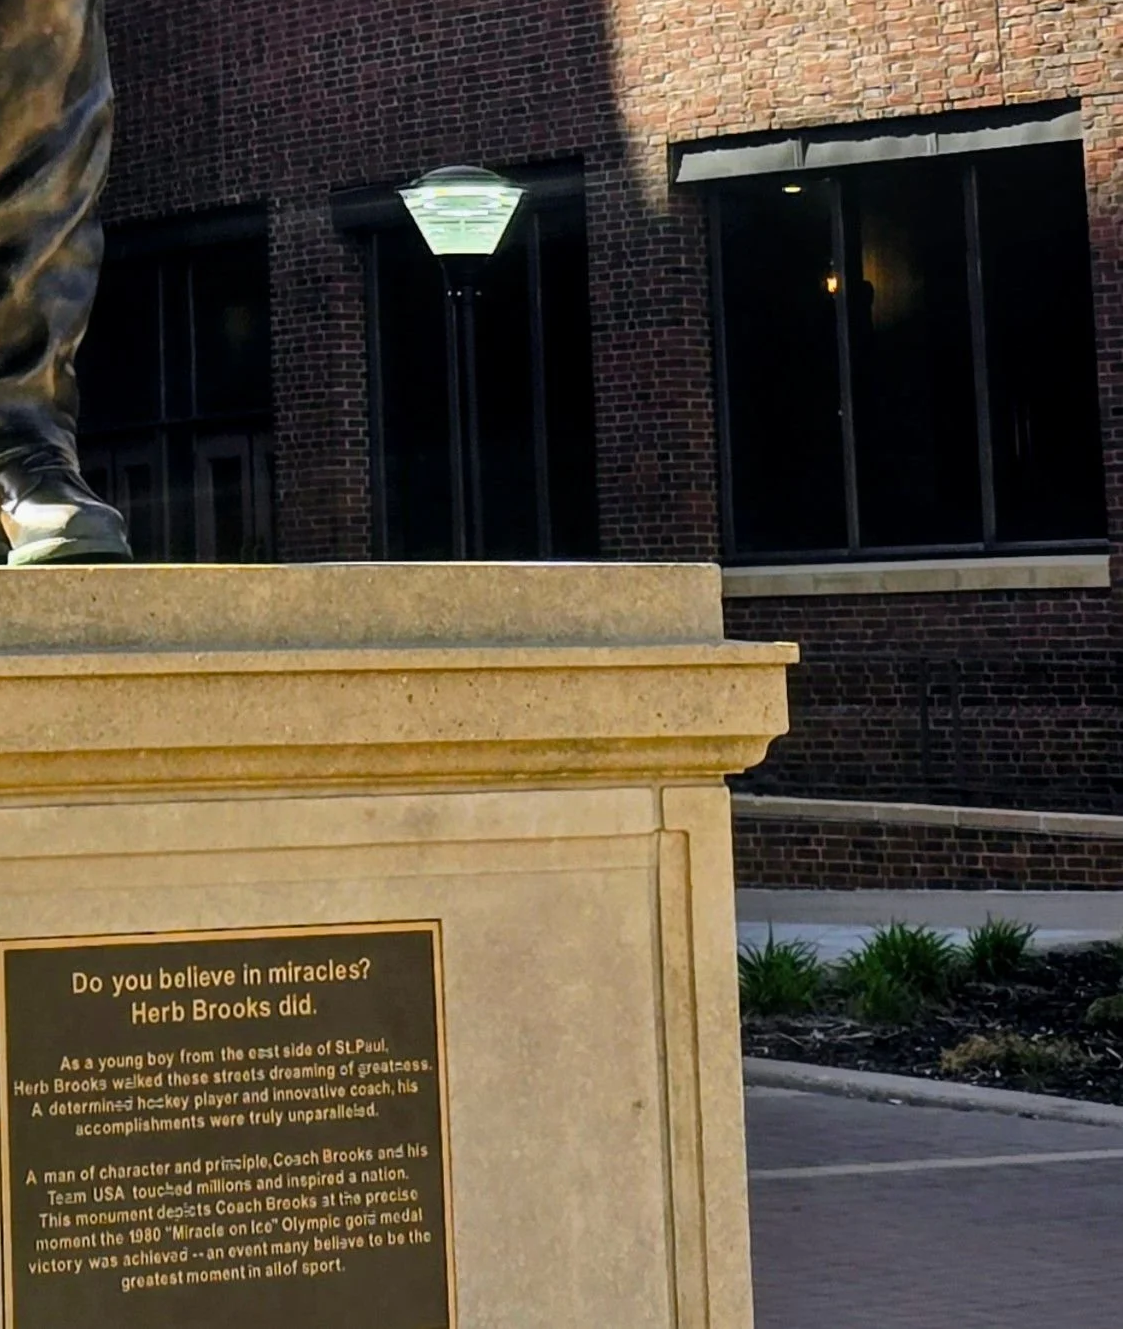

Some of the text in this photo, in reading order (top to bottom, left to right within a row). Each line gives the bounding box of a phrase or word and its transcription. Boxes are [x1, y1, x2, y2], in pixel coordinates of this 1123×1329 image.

[72, 958, 370, 997] Do you believe in miracles?
[132, 993, 317, 1024] Herb Brooks did.
[60, 1056, 79, 1071] As
[85, 1058, 93, 1069] a
[98, 1055, 143, 1072] young
[148, 1052, 173, 1068] boy
[180, 1049, 213, 1063] from
[221, 1047, 243, 1061] the
[249, 1045, 279, 1059] east
[283, 1042, 312, 1058] side
[318, 1040, 332, 1056] of
[14, 1080, 48, 1095] Herb
[55, 1077, 106, 1093] Brooks
[113, 1073, 162, 1090] walked
[168, 1072, 209, 1086] these
[214, 1068, 264, 1083] streets
[270, 1063, 335, 1080] dreaming
[340, 1061, 353, 1075] of
[32, 1079, 418, 1117] A determined hockey player and innovative coach, his
[76, 1115, 204, 1136] accomplishments
[210, 1114, 244, 1127] were
[250, 1108, 282, 1126] truly
[26, 1170, 37, 1185] A
[44, 1171, 75, 1183] man
[80, 1165, 95, 1181] of
[100, 1162, 169, 1180] character
[175, 1158, 200, 1174] and
[274, 1150, 318, 1167] Coach
[323, 1147, 373, 1164] Brooks
[378, 1144, 403, 1160] and
[408, 1144, 428, 1157] his
[47, 1167, 408, 1205] Team USA touched millions and inspired a nation.
[39, 1187, 418, 1228] This monument depicts Coach Brooks at the precise
[36, 1233, 96, 1250] moment
[101, 1231, 123, 1246] the
[129, 1227, 161, 1244] 1980
[230, 1224, 247, 1236] on
[282, 1214, 341, 1234] Olympic
[346, 1214, 376, 1231] gold
[380, 1208, 422, 1224] medal
[29, 1259, 82, 1274] victory
[89, 1256, 117, 1269] was
[123, 1247, 188, 1266] achieved
[207, 1248, 224, 1260] an
[228, 1242, 267, 1258] event
[271, 1241, 309, 1256] many
[314, 1235, 363, 1251] believe
[369, 1233, 382, 1247] to
[388, 1231, 404, 1245] be
[409, 1229, 431, 1244] the
[122, 1270, 183, 1292] greatest
[187, 1265, 245, 1283] moment
[249, 1265, 261, 1278] in
[302, 1258, 345, 1276] sport.
